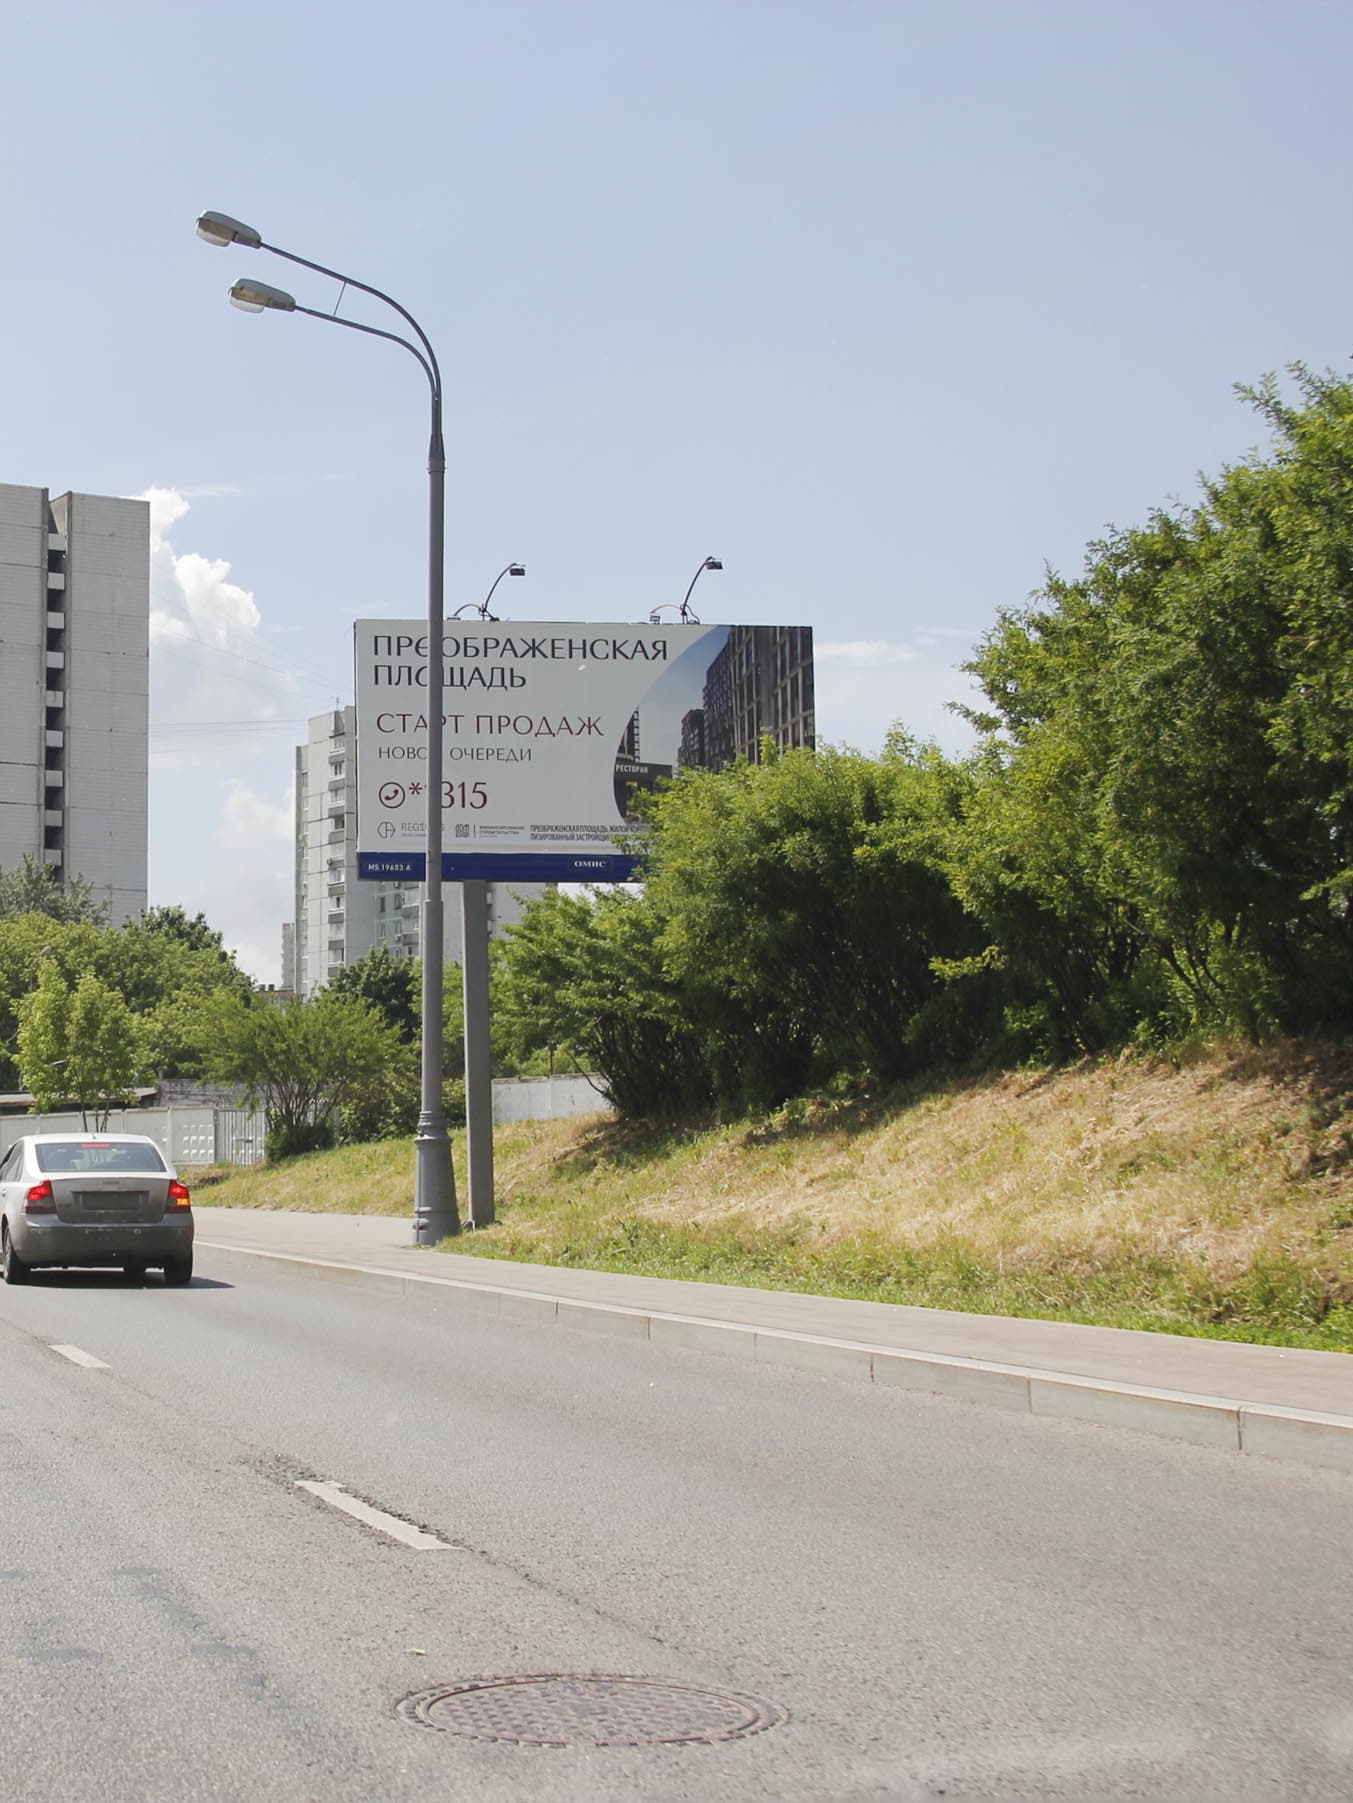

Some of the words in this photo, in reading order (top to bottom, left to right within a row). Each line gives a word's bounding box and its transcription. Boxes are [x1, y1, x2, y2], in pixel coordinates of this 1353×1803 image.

[374, 635, 667, 660] ПРЕОБРАЖЕНСКАЯ
[374, 665, 526, 691] ПЛОЩАДЬ
[476, 714, 604, 737] ПРОДАЖ
[378, 746, 430, 760] НОВО
[449, 747, 531, 762] ОЧЕРЕДИ
